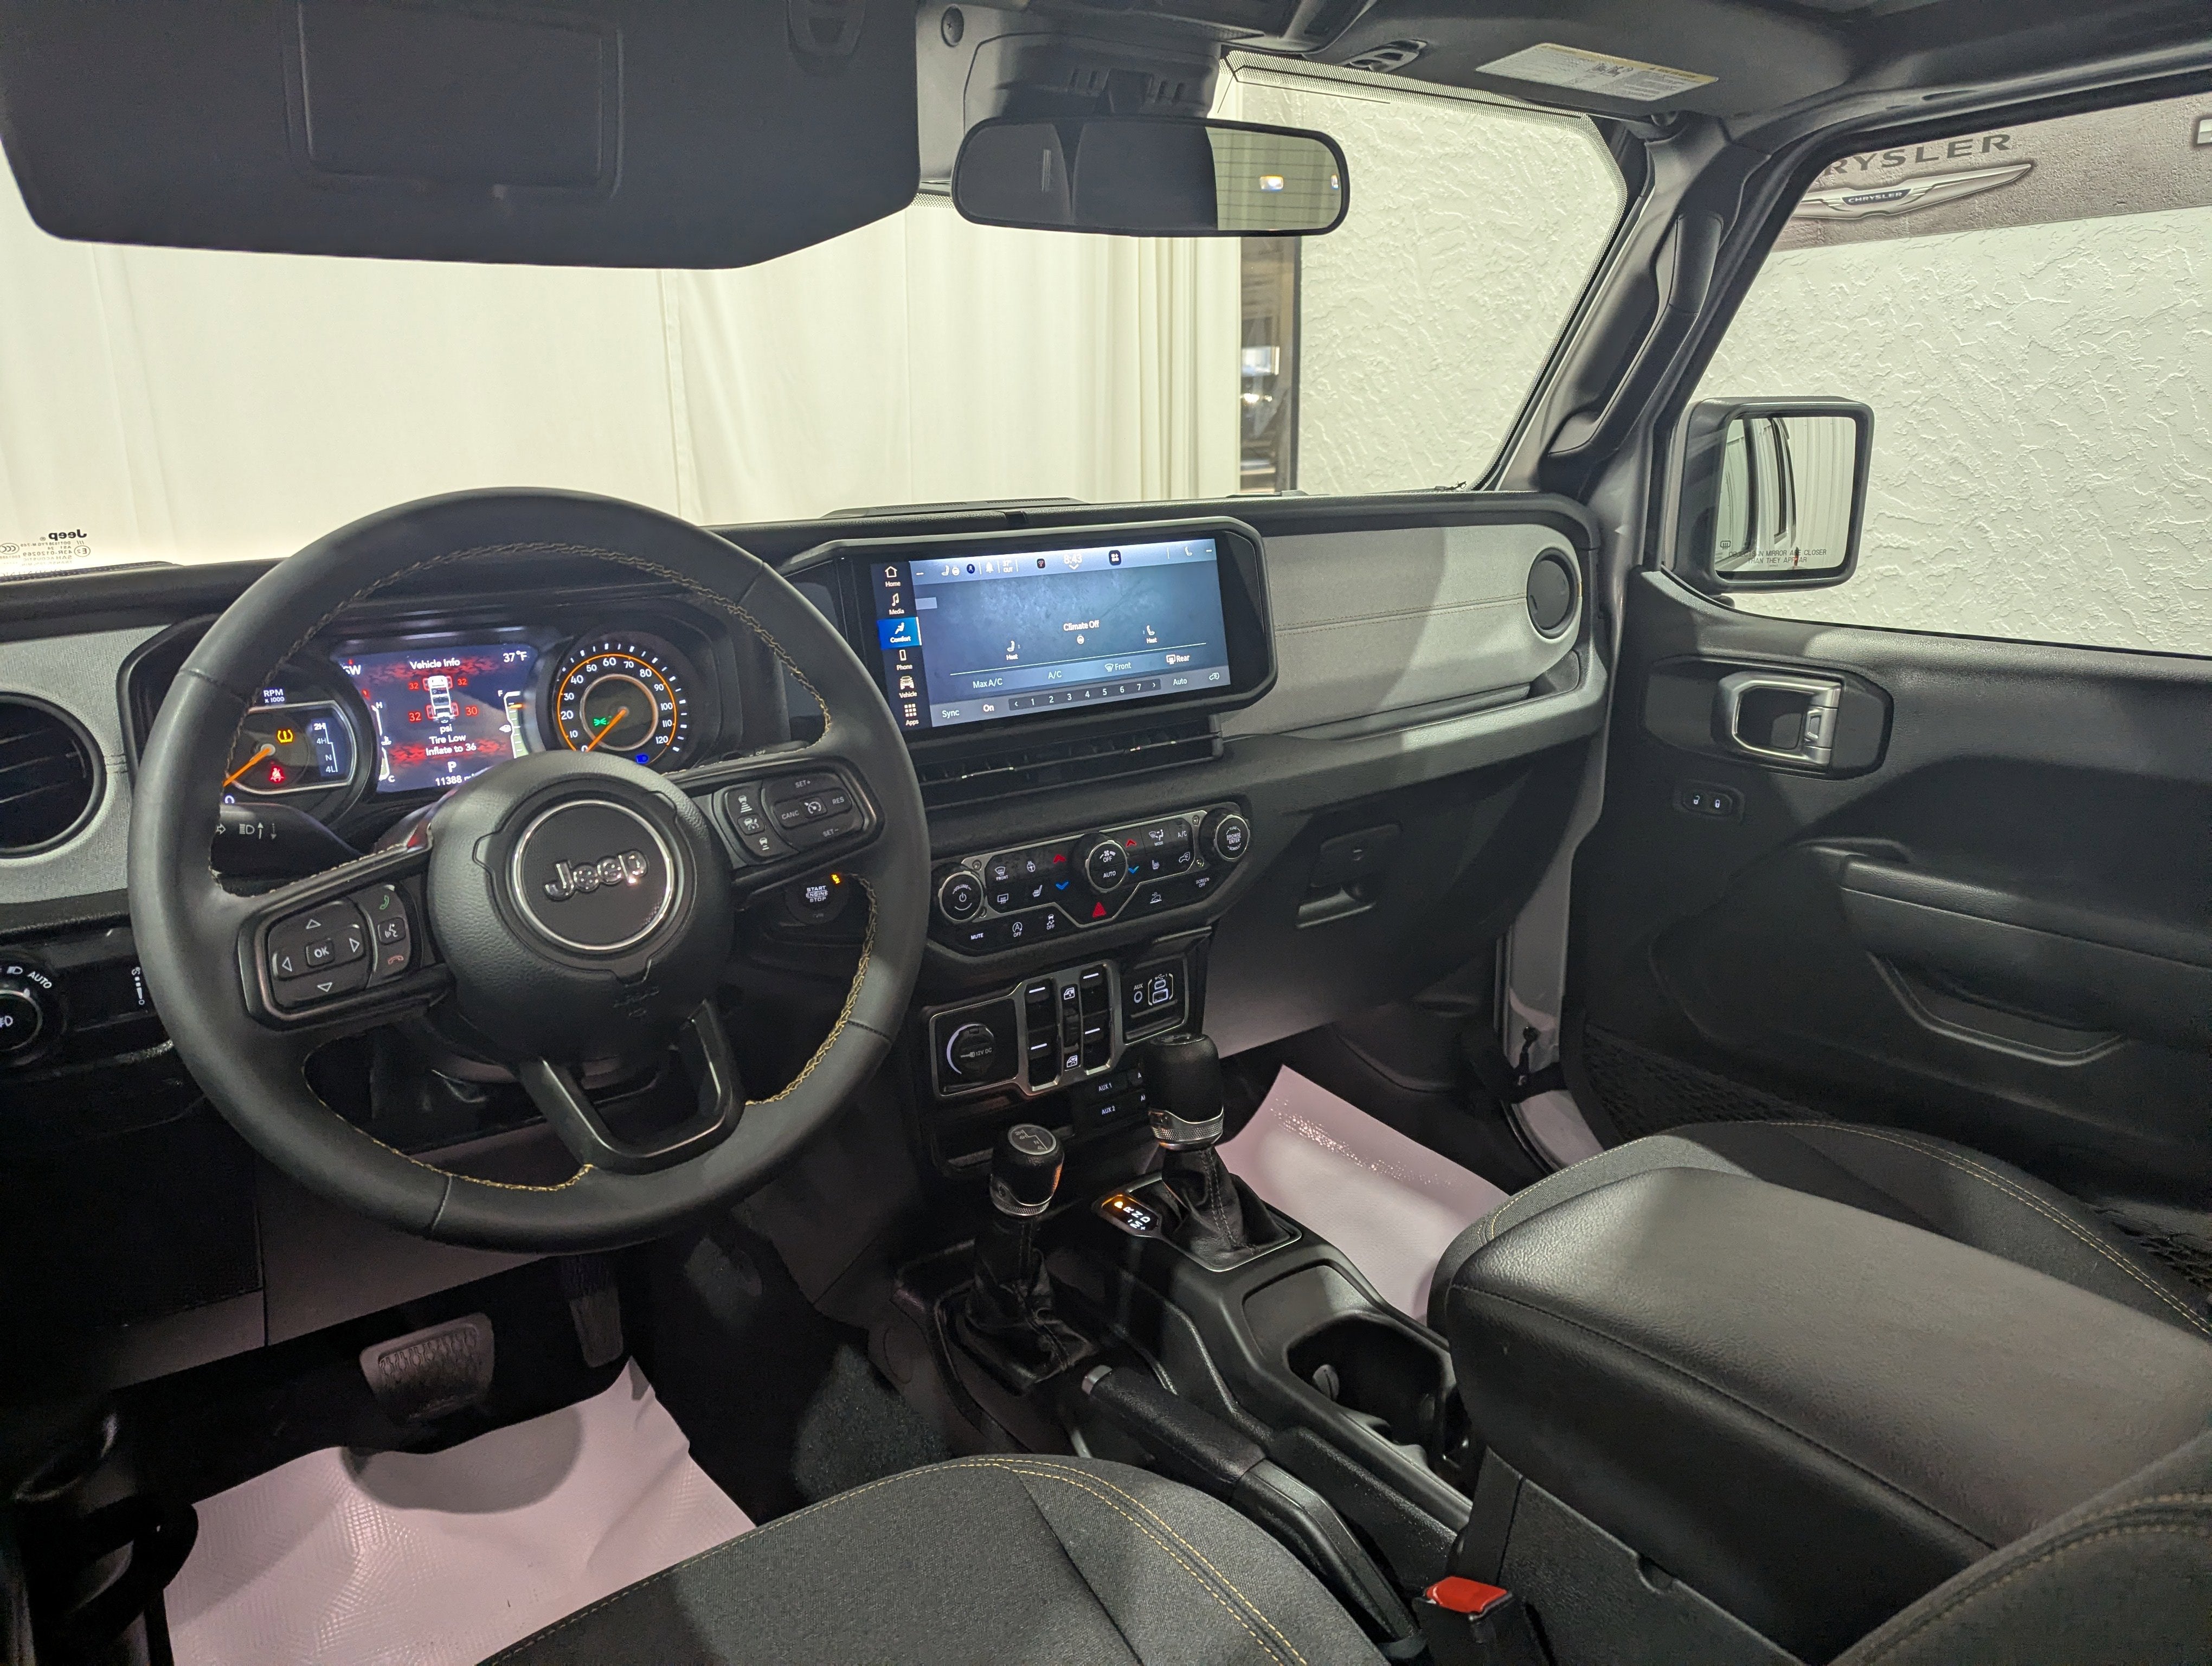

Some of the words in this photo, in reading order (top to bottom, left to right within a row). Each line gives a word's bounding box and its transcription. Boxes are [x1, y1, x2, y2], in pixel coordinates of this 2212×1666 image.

[1848, 191, 1903, 203] CHRYSLER
[1064, 553, 1083, 564] 8:43
[1063, 621, 1088, 631] Climate
[1089, 620, 1099, 629] Off
[503, 650, 528, 663] 37°F
[1176, 654, 1190, 662] Rear
[409, 659, 442, 670] Vehicle
[443, 658, 461, 667] Info
[602, 657, 617, 666] 60
[1115, 662, 1131, 670] Front
[586, 664, 597, 672] 50
[639, 668, 652, 677] 80
[1048, 670, 1062, 679] A/C
[458, 678, 467, 686] 32
[570, 675, 584, 684] 40
[973, 680, 988, 689] Max
[988, 678, 1002, 686] A/C
[263, 689, 284, 697] RPM
[563, 693, 575, 701] 30
[465, 706, 478, 715] 30
[660, 702, 673, 710] 100
[983, 704, 994, 712] On
[409, 712, 421, 722] 32
[561, 710, 574, 720] 20
[942, 709, 960, 719] Sync
[439, 724, 453, 734] psi
[569, 730, 578, 738] 10
[429, 735, 447, 745] Tire
[448, 734, 467, 744] Low
[655, 735, 668, 744] 120
[426, 747, 453, 757] Inflate
[453, 745, 464, 754] to
[465, 744, 477, 752] 36
[447, 761, 457, 773] P
[388, 775, 395, 783] C
[435, 775, 462, 786] 11388
[832, 796, 845, 805] RES
[781, 810, 799, 820] CANC
[544, 849, 648, 901] Jeep
[1103, 870, 1116, 879] AUTO
[314, 945, 330, 958] OK
[27, 971, 52, 989] AUTO
